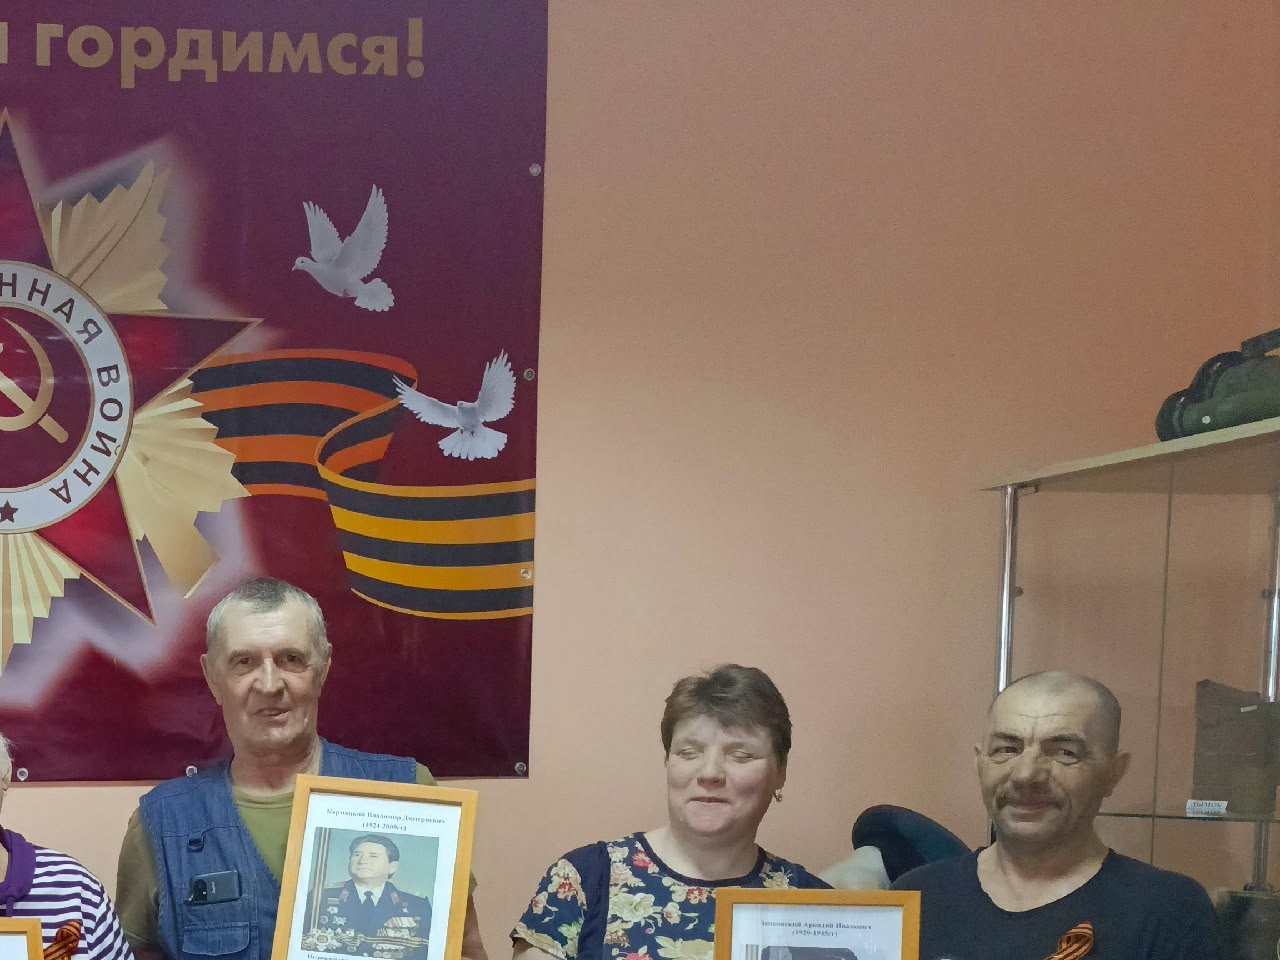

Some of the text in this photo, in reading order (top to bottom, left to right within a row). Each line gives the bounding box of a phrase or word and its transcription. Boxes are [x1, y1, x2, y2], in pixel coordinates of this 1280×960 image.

[36, 17, 425, 89] гордимся!
[48, 363, 124, 504] ВОЙНА
[366, 812, 401, 821] Владимир
[836, 922, 871, 930] Иванович
